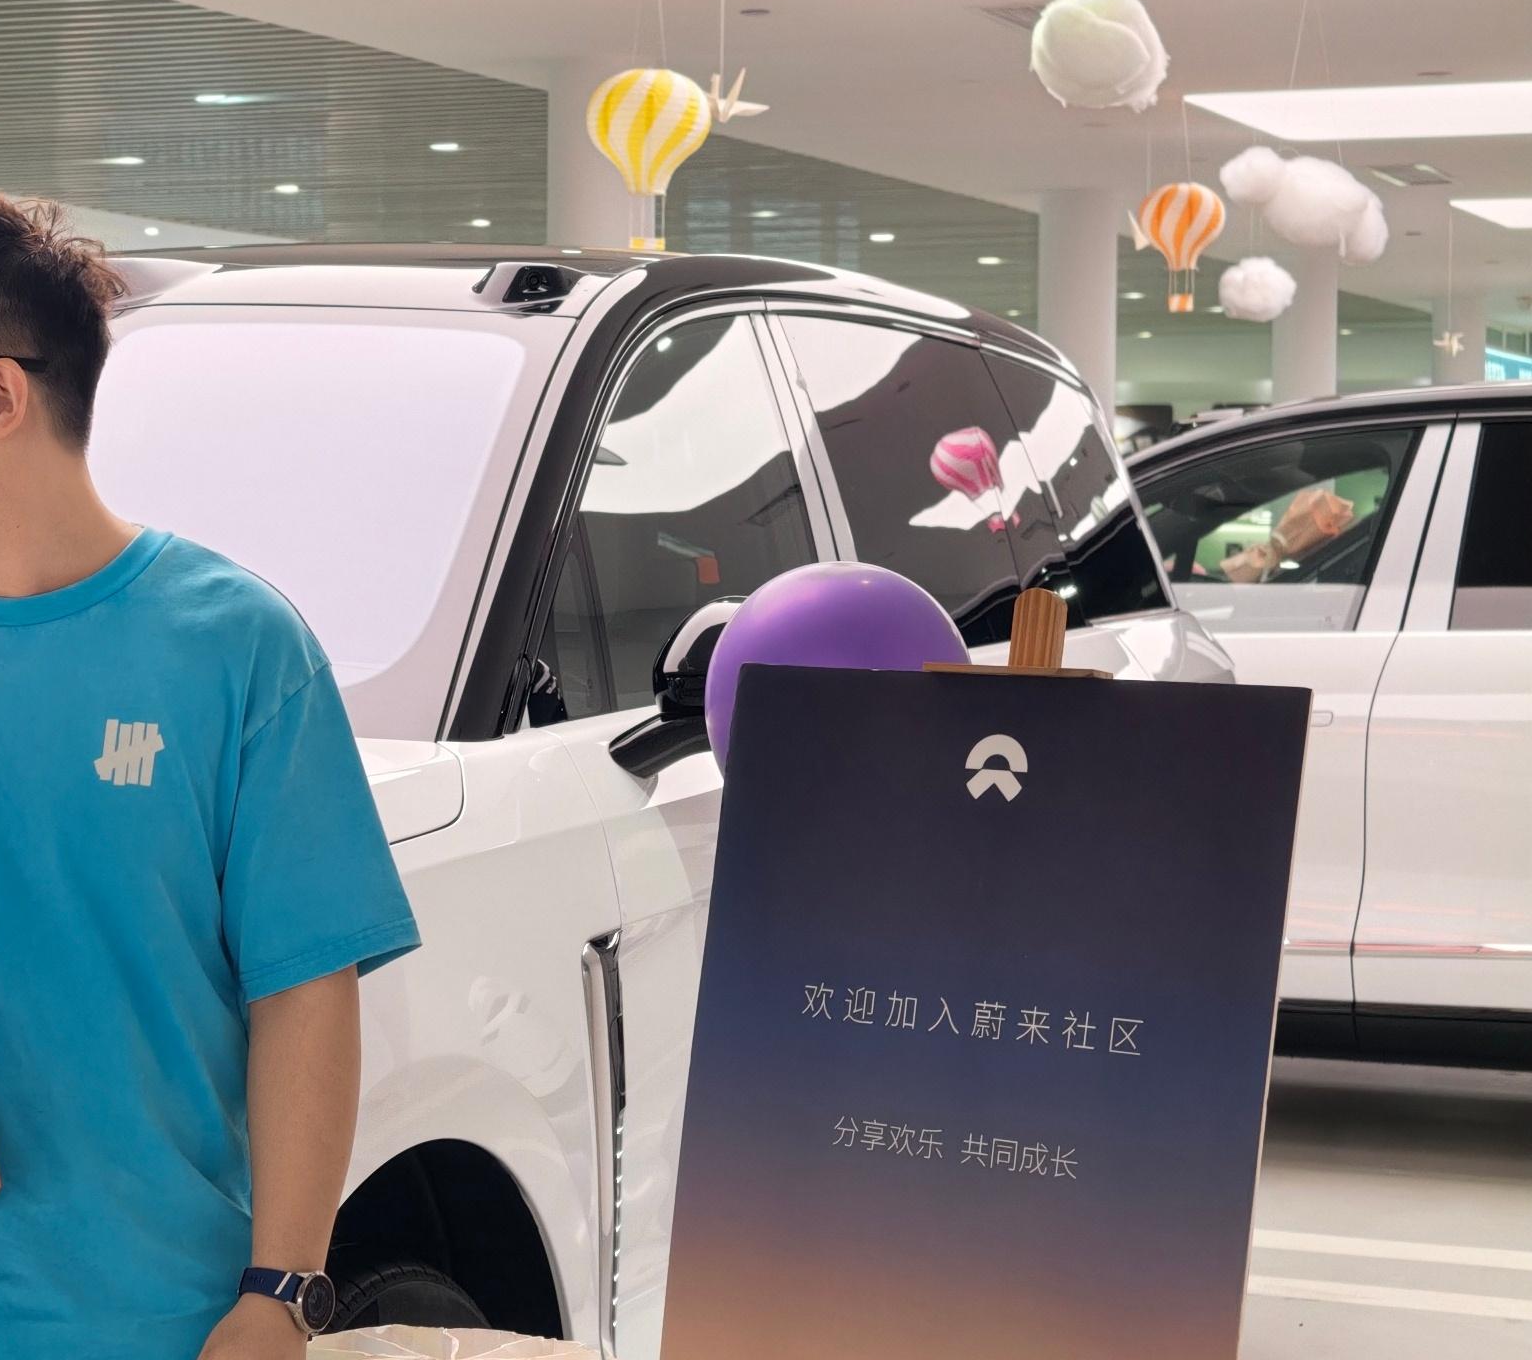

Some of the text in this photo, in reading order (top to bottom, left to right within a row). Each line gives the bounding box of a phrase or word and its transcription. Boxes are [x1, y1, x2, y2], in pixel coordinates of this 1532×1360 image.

[801, 982, 1145, 1057] 欢迎加入蔚来社区
[831, 1115, 1079, 1180] 分享欢乐 共同成长
